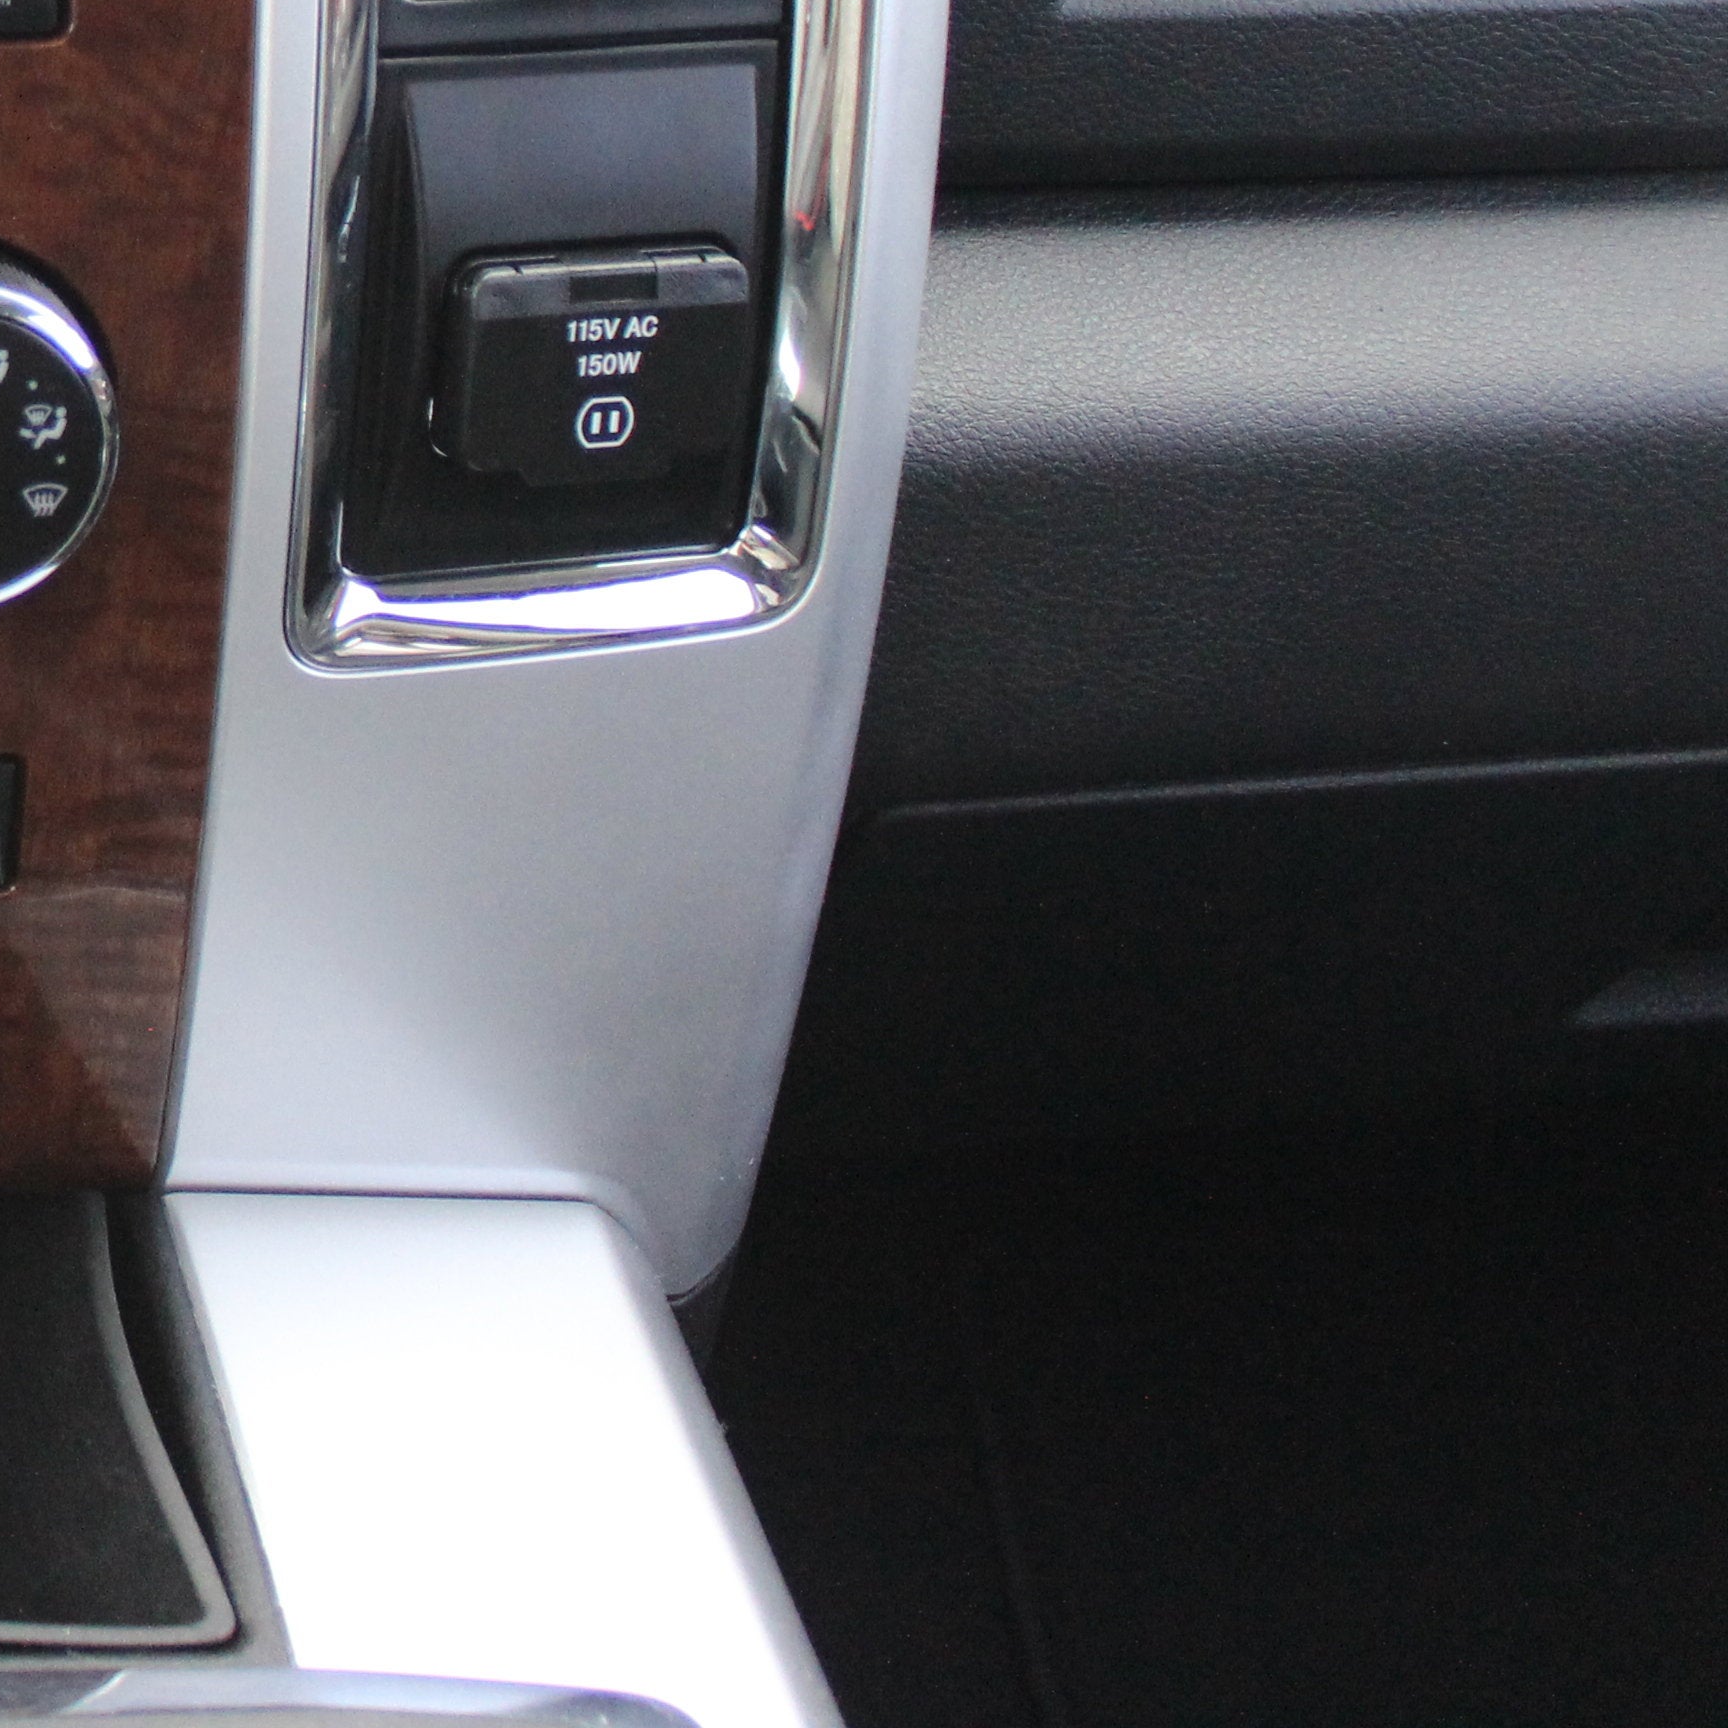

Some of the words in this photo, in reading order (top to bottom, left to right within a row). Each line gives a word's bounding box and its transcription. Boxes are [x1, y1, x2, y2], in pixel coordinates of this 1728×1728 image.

[567, 317, 622, 342] 115V
[624, 315, 658, 339] AC
[576, 350, 642, 378] 150W
